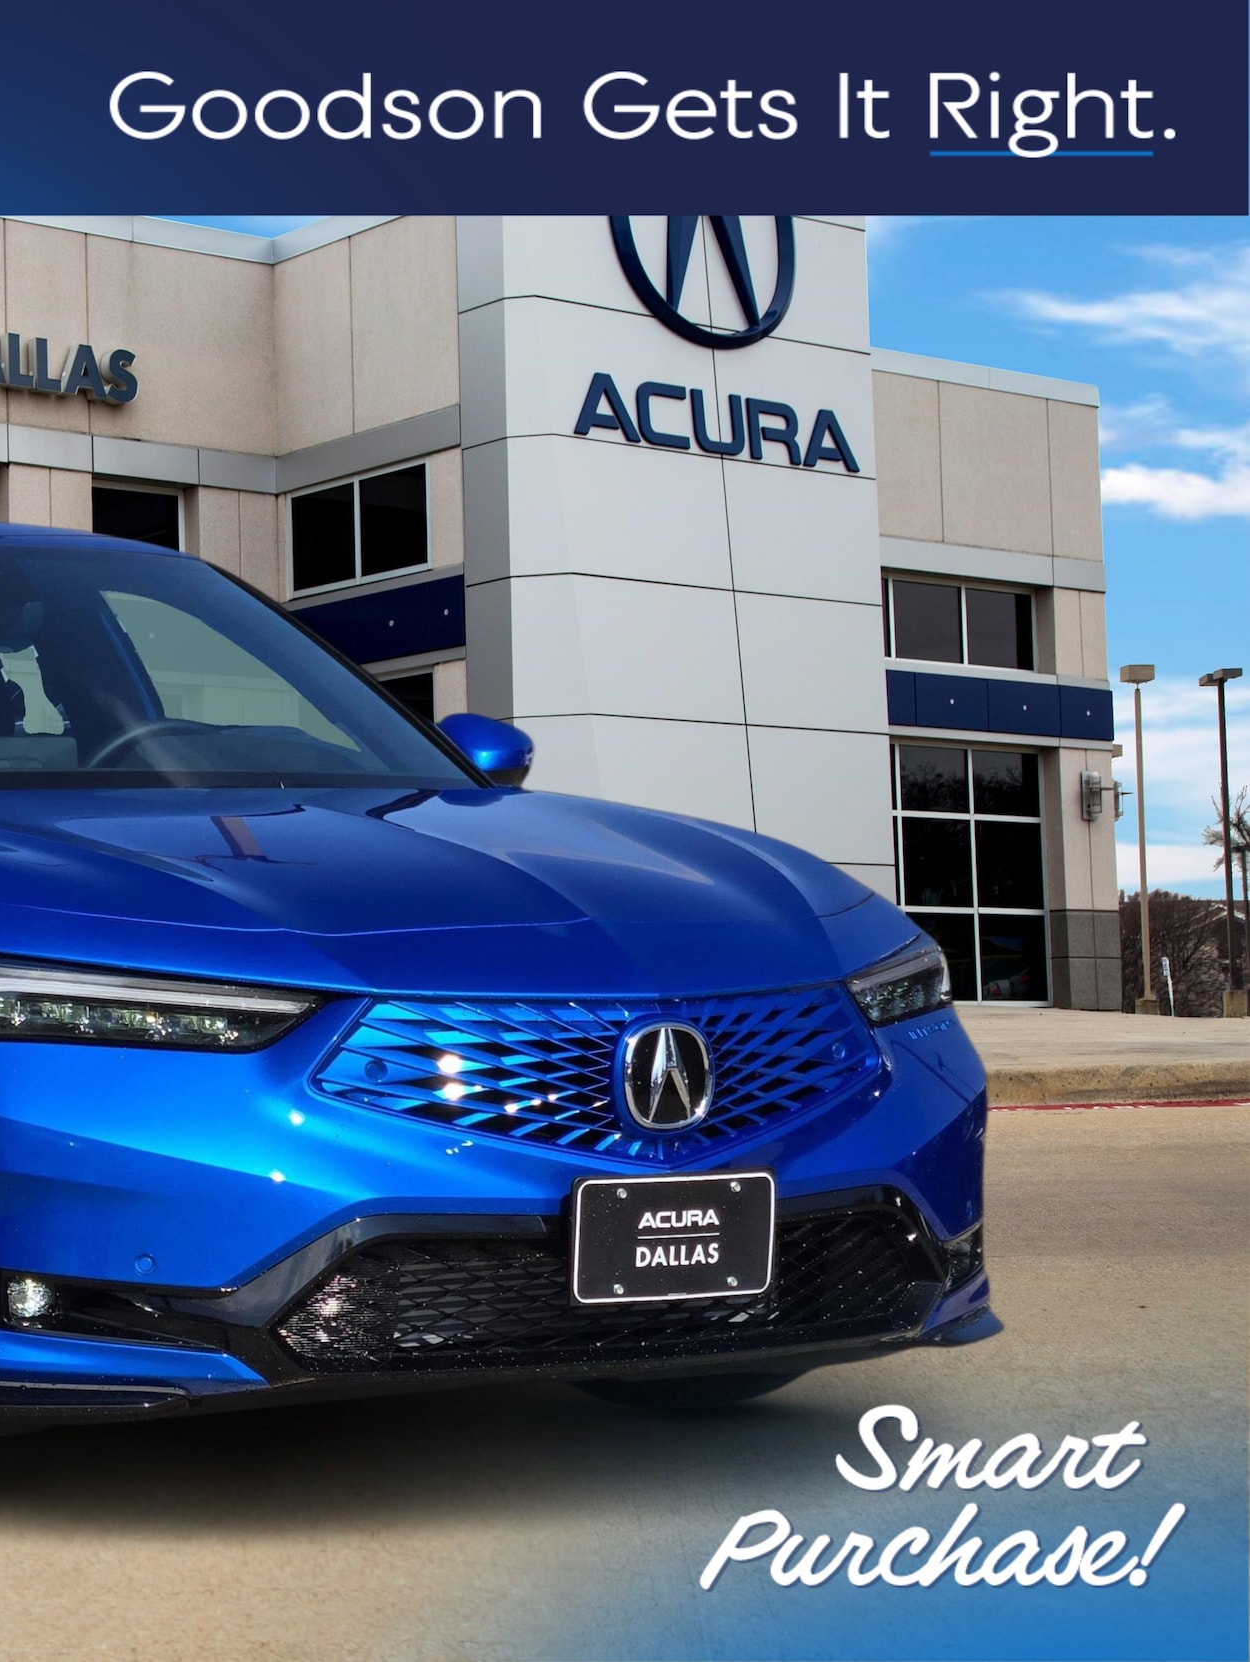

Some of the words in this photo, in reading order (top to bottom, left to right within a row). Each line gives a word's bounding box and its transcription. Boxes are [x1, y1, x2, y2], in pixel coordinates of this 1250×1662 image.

[573, 372, 860, 473] ACURA
[637, 1208, 720, 1230] ACURA
[635, 1242, 720, 1268] DALLAS
